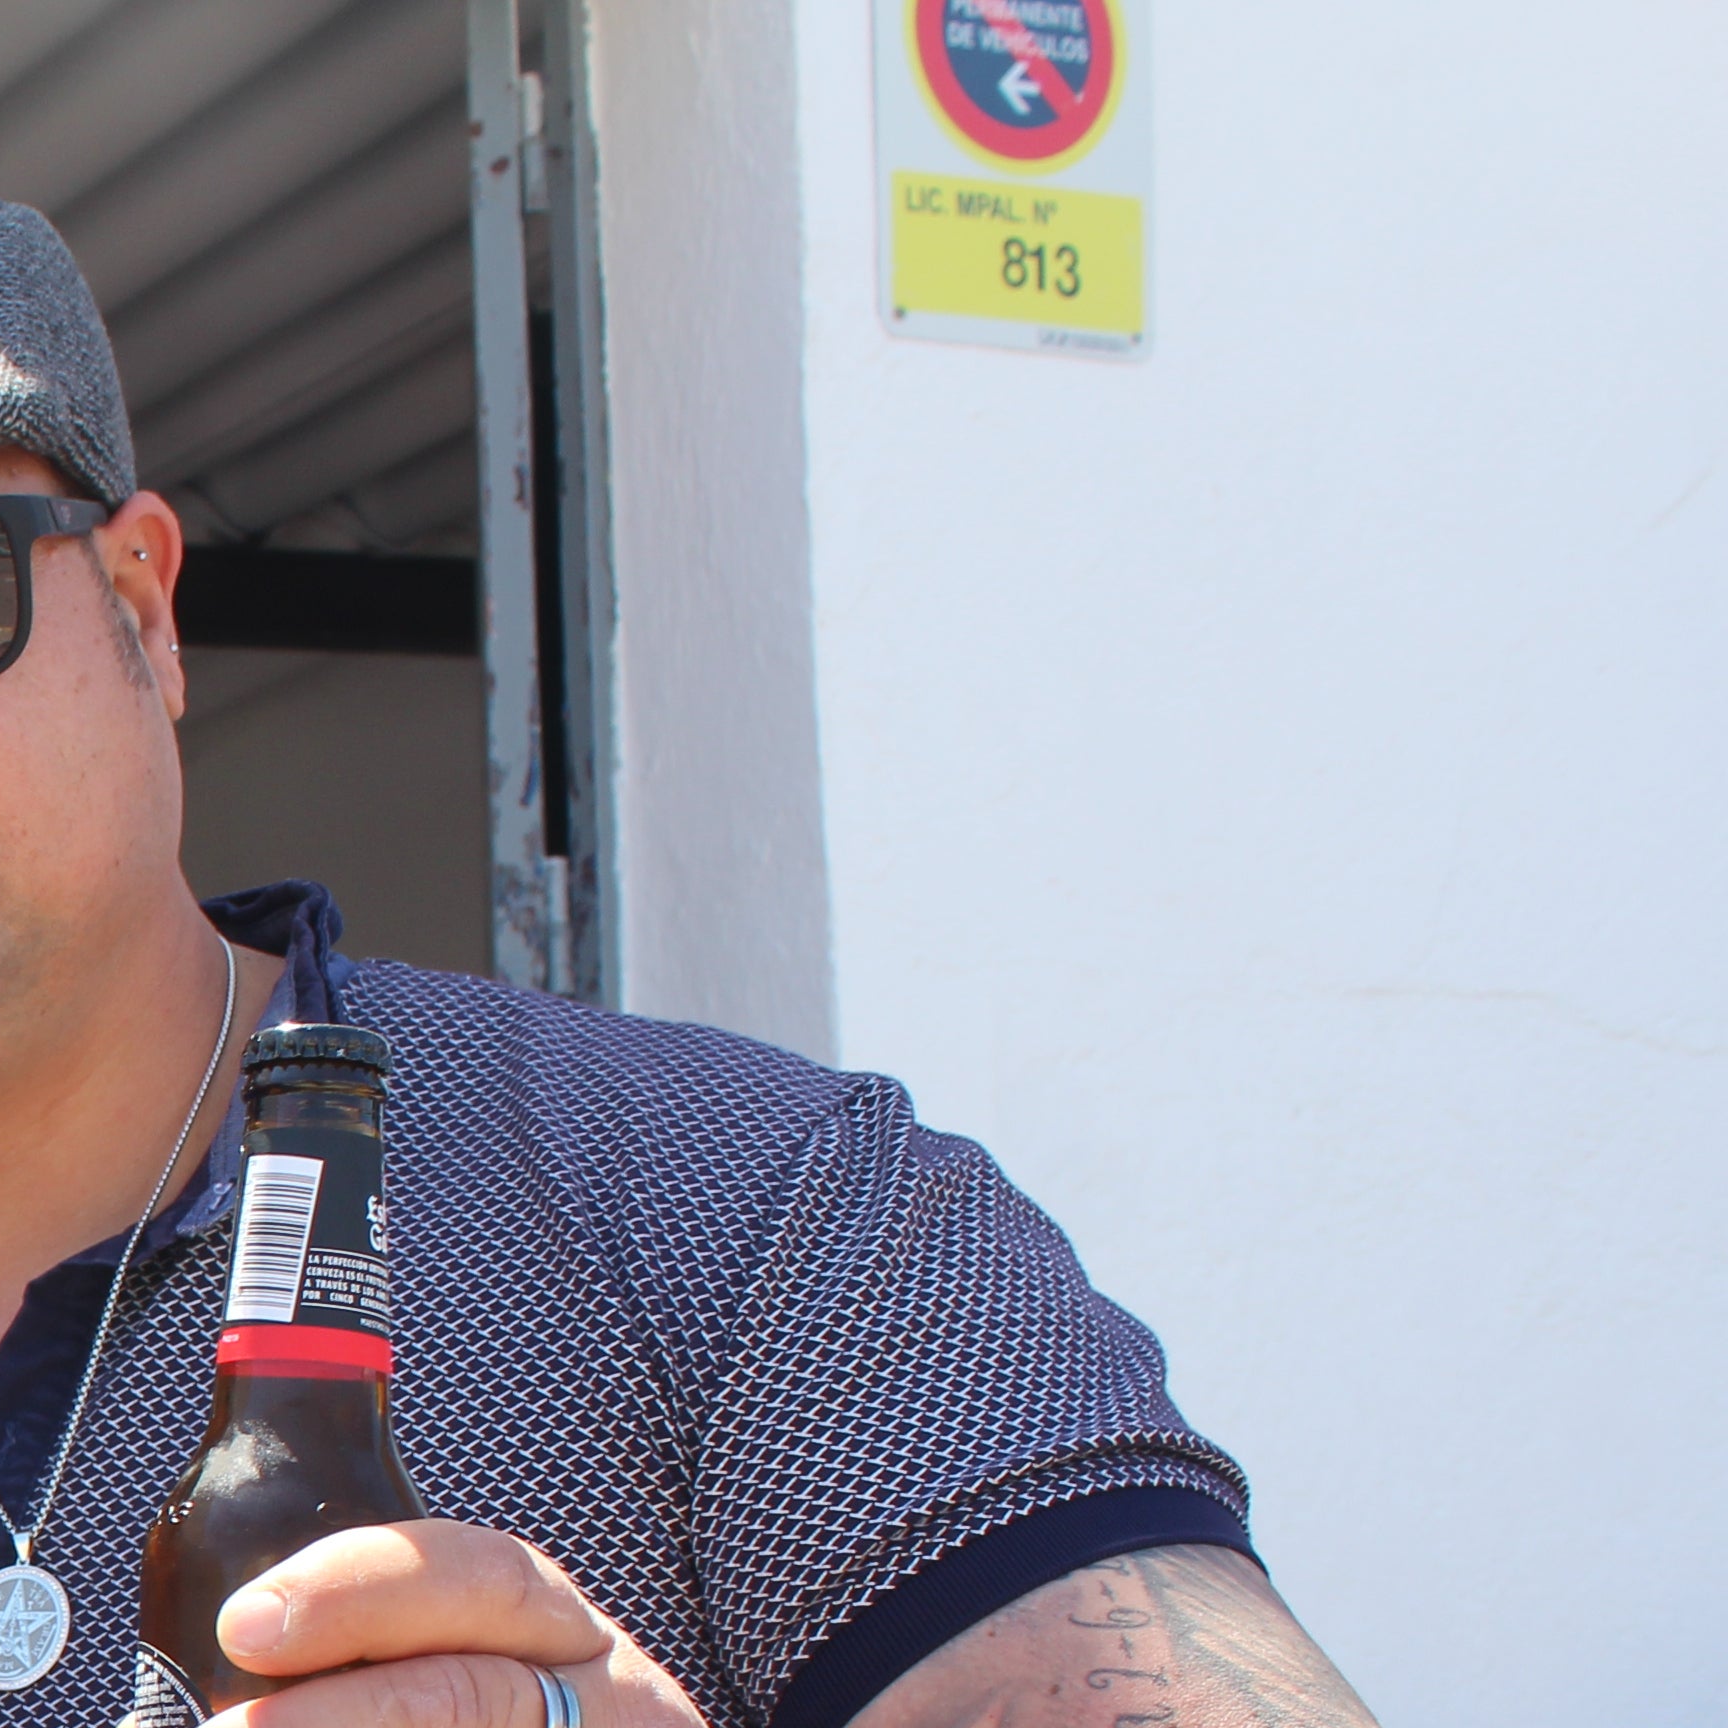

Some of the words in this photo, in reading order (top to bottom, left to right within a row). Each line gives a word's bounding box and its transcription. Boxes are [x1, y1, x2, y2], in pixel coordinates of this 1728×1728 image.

[946, 20, 975, 50] DE
[1002, 237, 1082, 299] 813
[306, 1266, 344, 1279] CERVEZA
